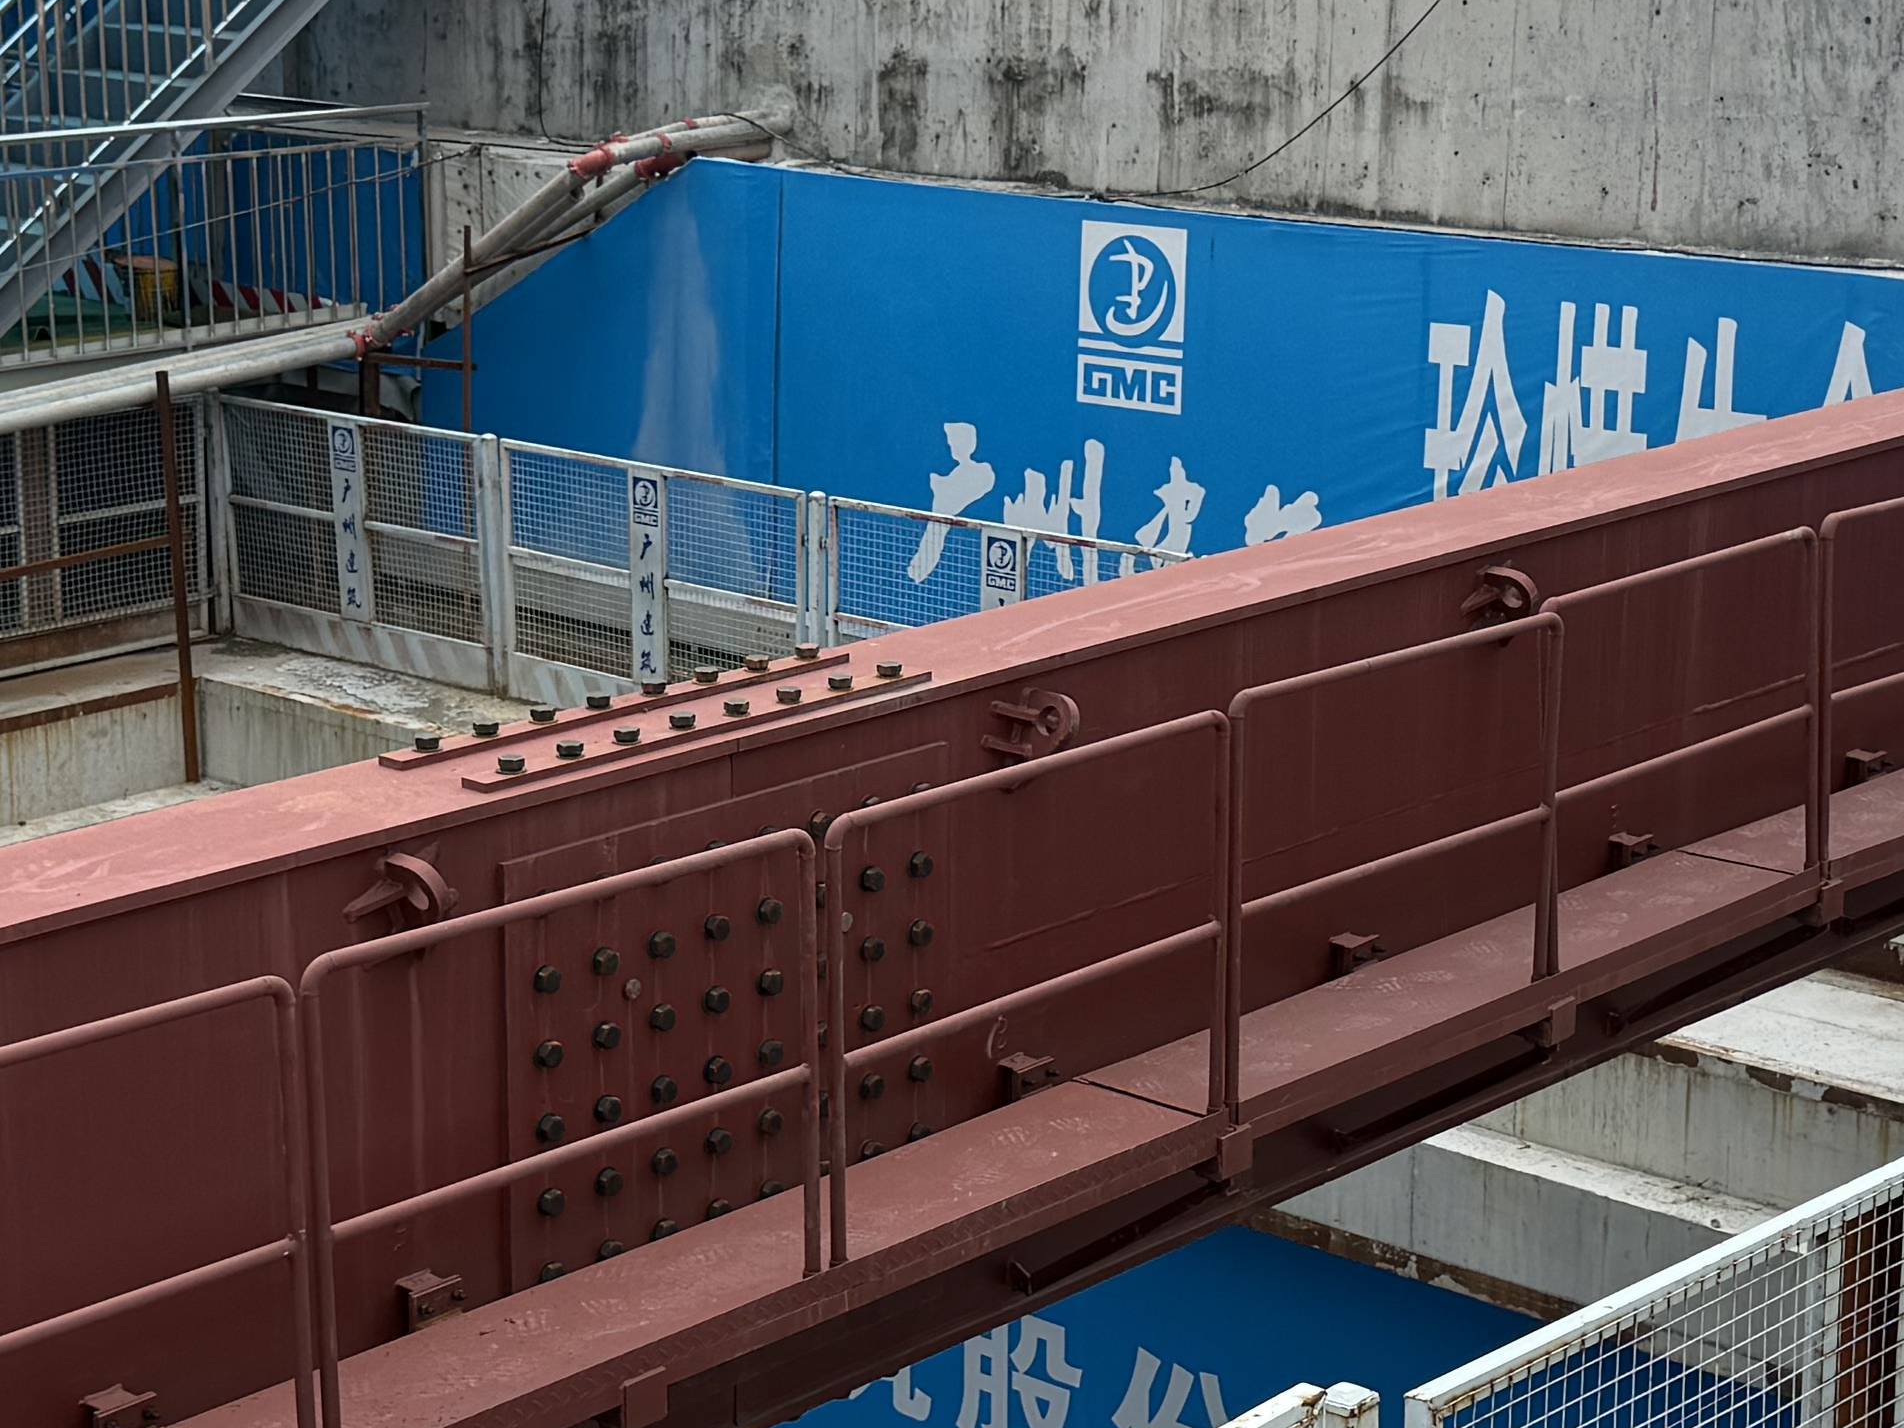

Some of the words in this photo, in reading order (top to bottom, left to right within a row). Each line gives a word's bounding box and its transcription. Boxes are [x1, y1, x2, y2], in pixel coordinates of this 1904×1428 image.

[1078, 361, 1180, 408] GMC
[342, 477, 362, 609] 广州建筑
[986, 574, 1016, 592] GMC
[639, 533, 657, 674] 广州建筑
